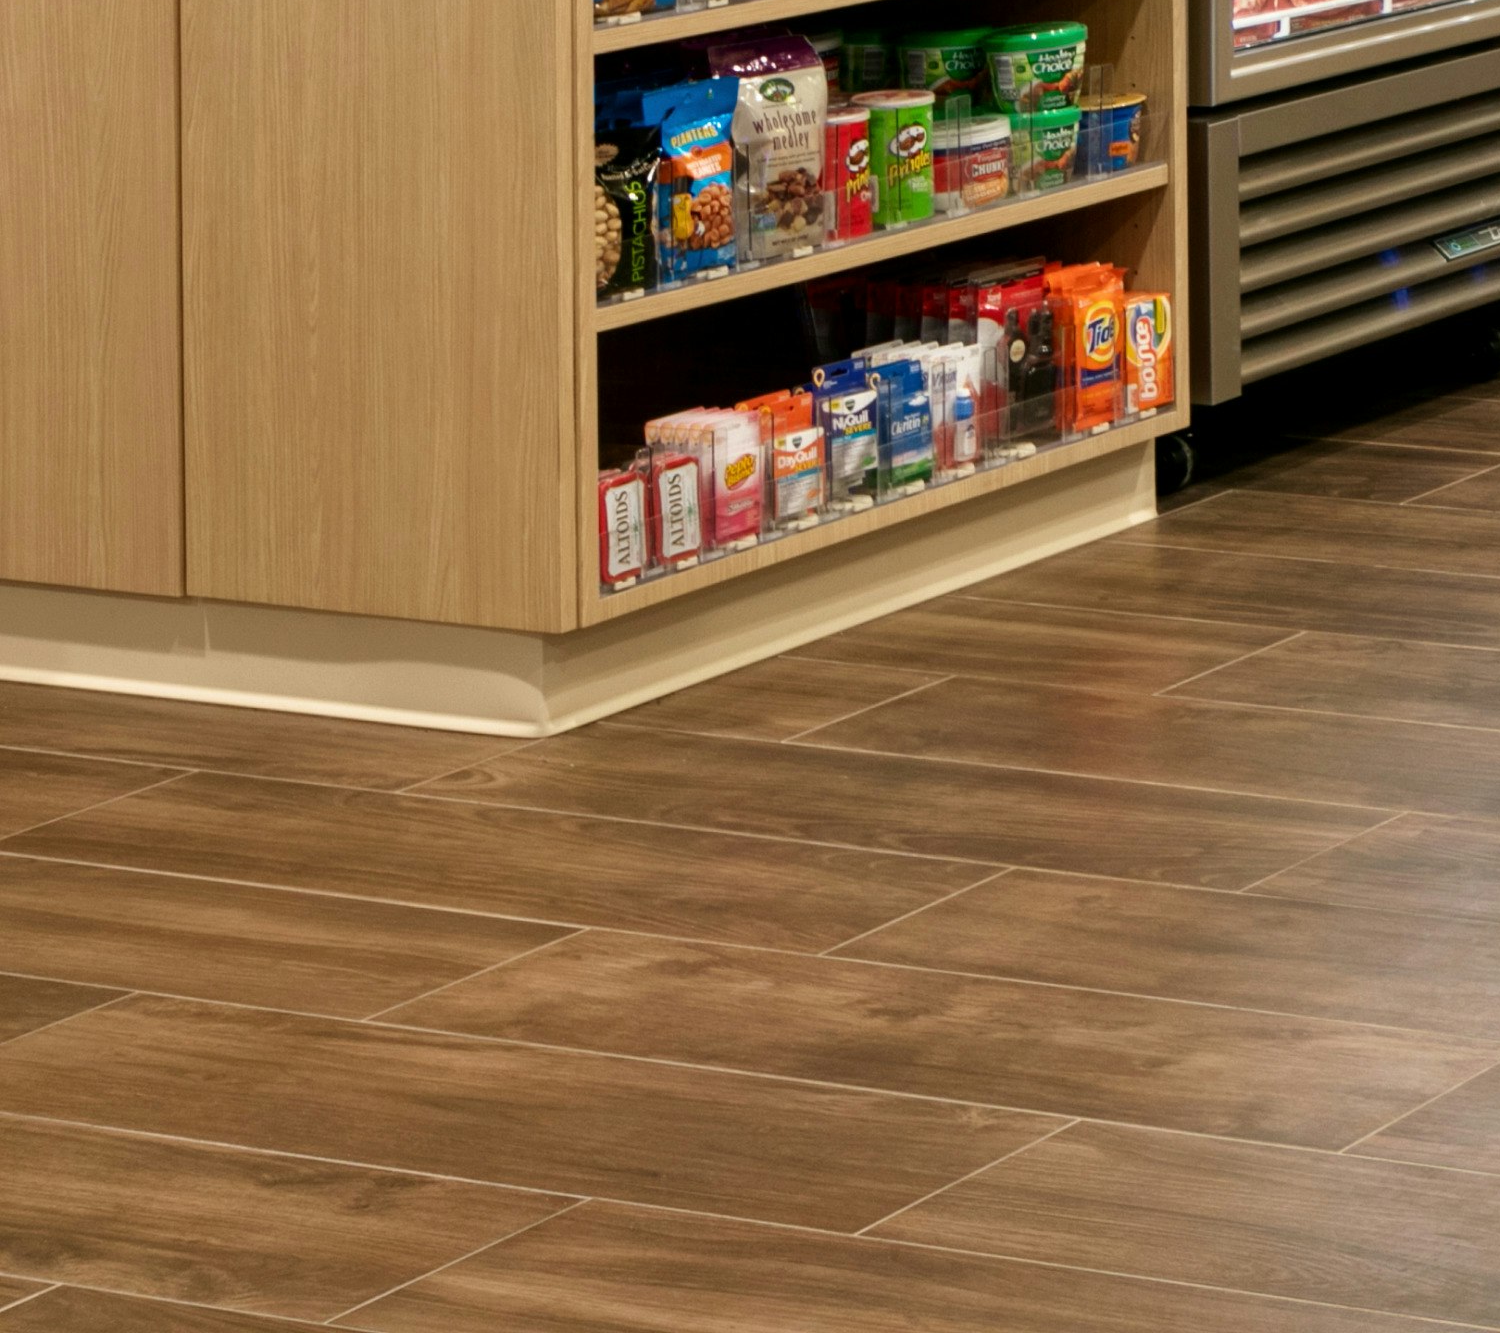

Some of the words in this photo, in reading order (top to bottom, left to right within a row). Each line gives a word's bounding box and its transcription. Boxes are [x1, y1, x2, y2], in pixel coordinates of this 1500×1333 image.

[1032, 58, 1073, 75] Choice
[752, 109, 817, 134] wholesome
[772, 129, 810, 152] medley
[888, 150, 931, 188] Pringles
[1087, 314, 1116, 357] Tide
[1135, 315, 1158, 400] bounce
[777, 446, 818, 470] DayQuil
[614, 489, 631, 566] ALTOIDS
[668, 472, 685, 548] ALTOIDS
